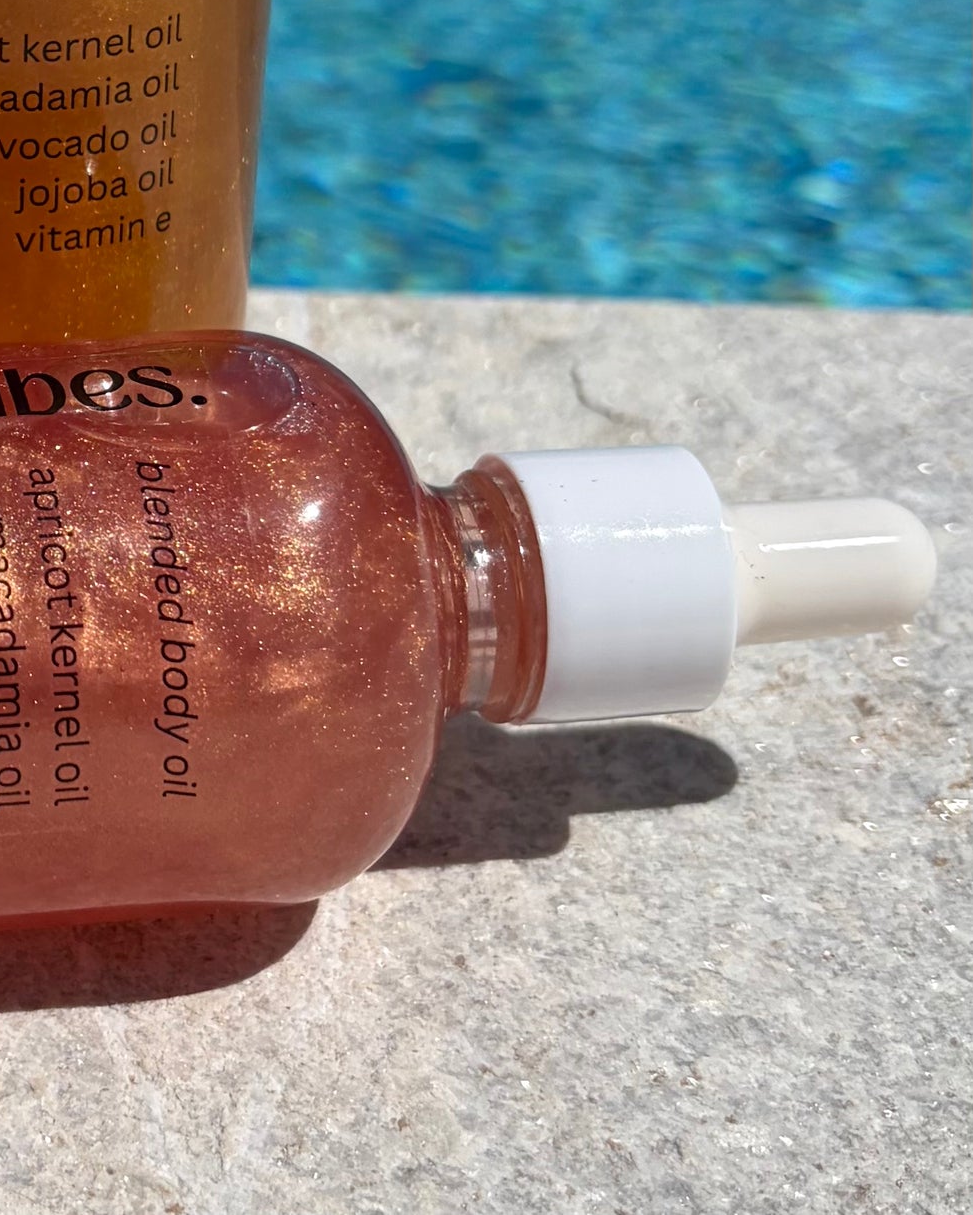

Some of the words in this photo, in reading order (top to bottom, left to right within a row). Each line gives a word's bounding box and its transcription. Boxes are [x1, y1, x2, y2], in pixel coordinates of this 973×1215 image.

[23, 24, 134, 63] kernel
[145, 13, 183, 49] oil
[143, 63, 179, 98] oil
[140, 111, 176, 145] oil
[14, 175, 127, 214] jojoba
[138, 158, 174, 193] oil
[15, 216, 145, 253] vitamin
[156, 210, 171, 233] e
[23, 467, 81, 612] apricot
[136, 461, 194, 625] blended
[49, 621, 89, 752] kernel
[154, 633, 198, 743] body
[54, 762, 89, 807] oil
[163, 754, 197, 798] oil
